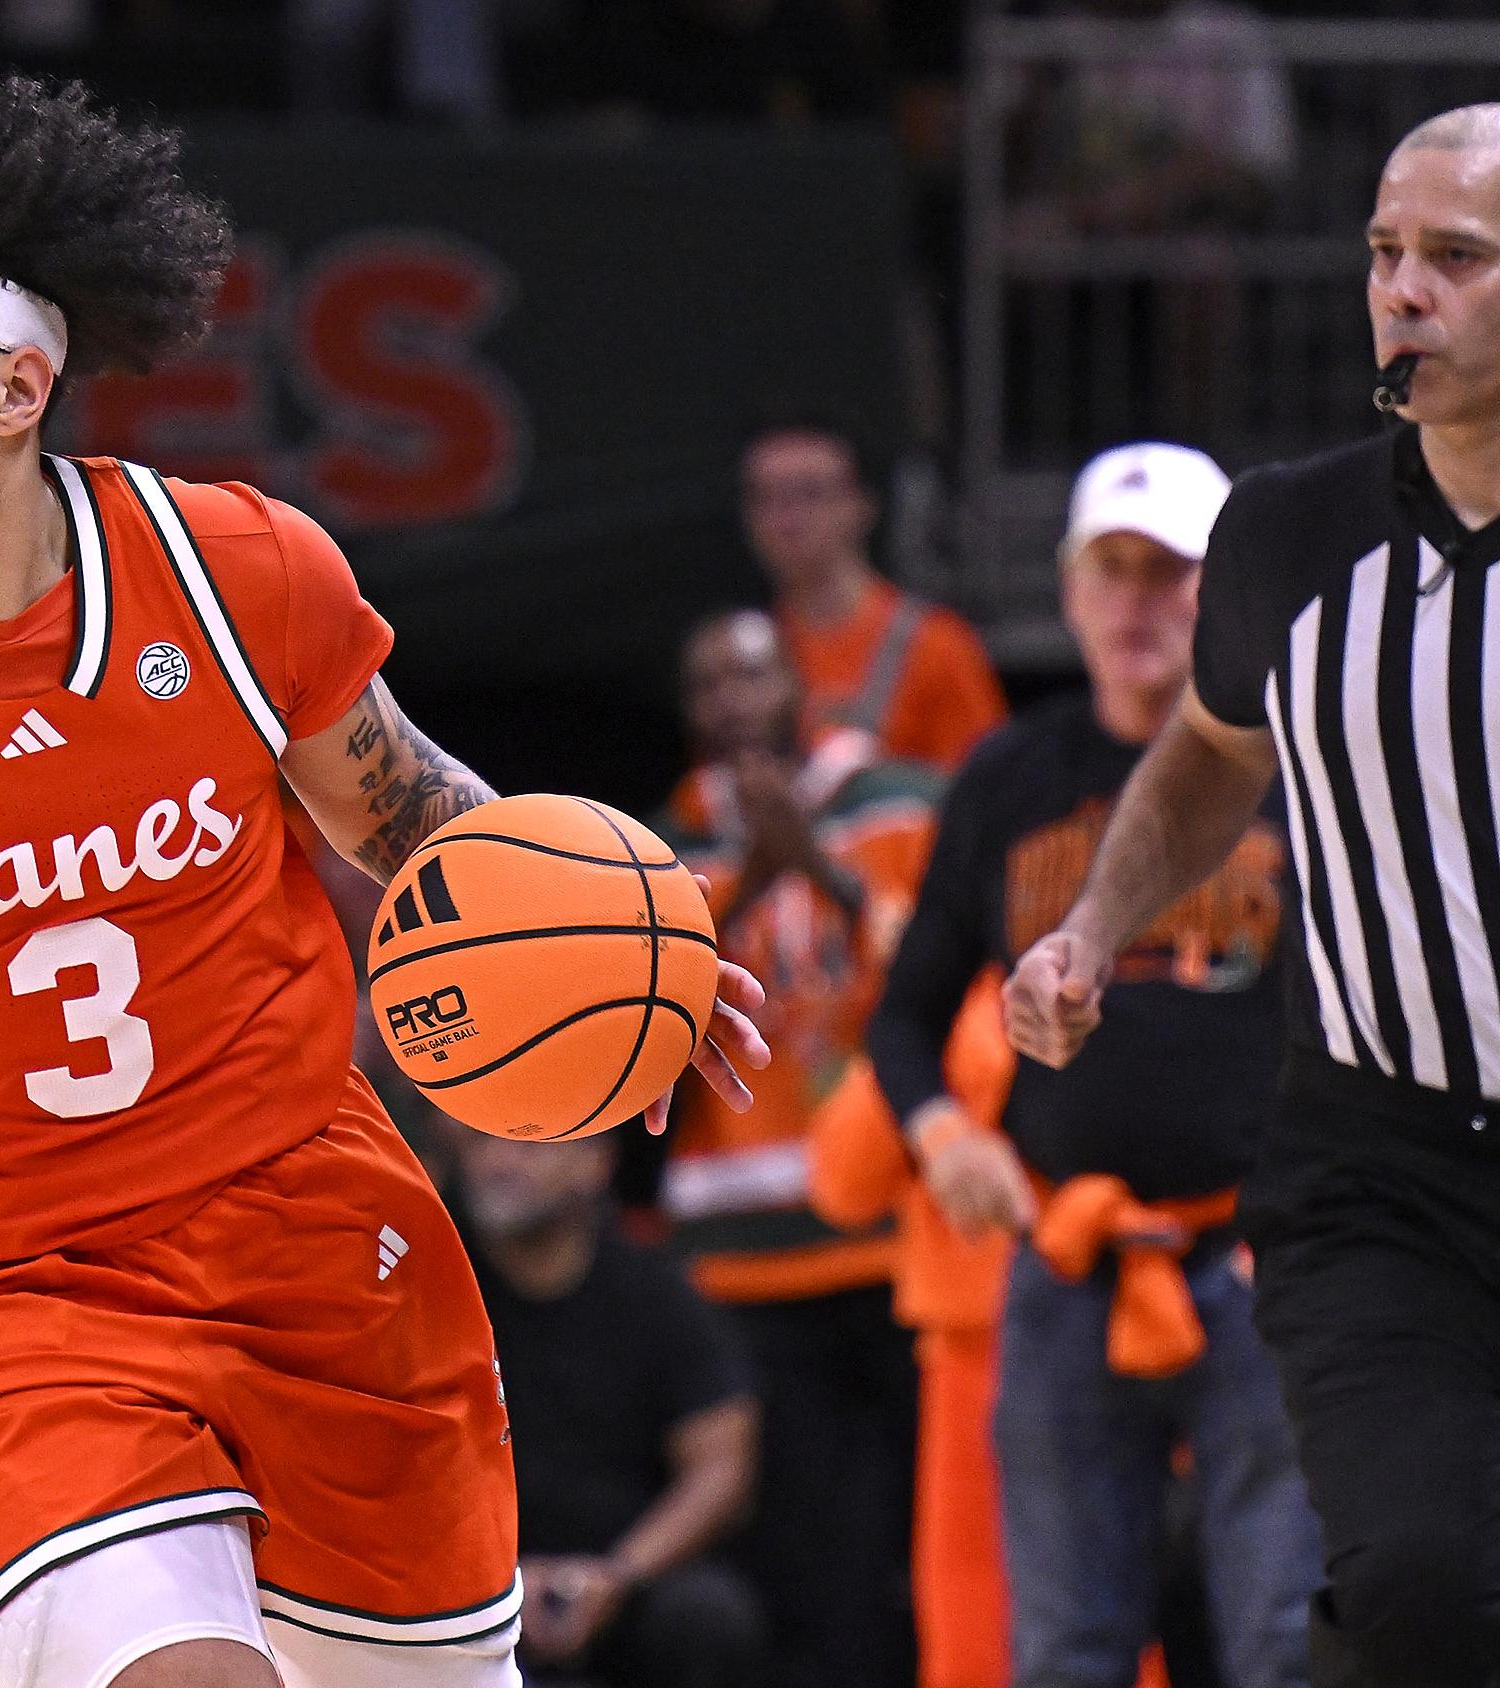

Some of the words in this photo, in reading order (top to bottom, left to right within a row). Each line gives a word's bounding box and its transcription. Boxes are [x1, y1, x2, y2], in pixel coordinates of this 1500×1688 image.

[146, 655, 182, 680] ACC
[7, 916, 155, 1119] 3
[386, 985, 467, 1039] PRO
[429, 1032, 454, 1050] GAME
[453, 1025, 480, 1042] BALL
